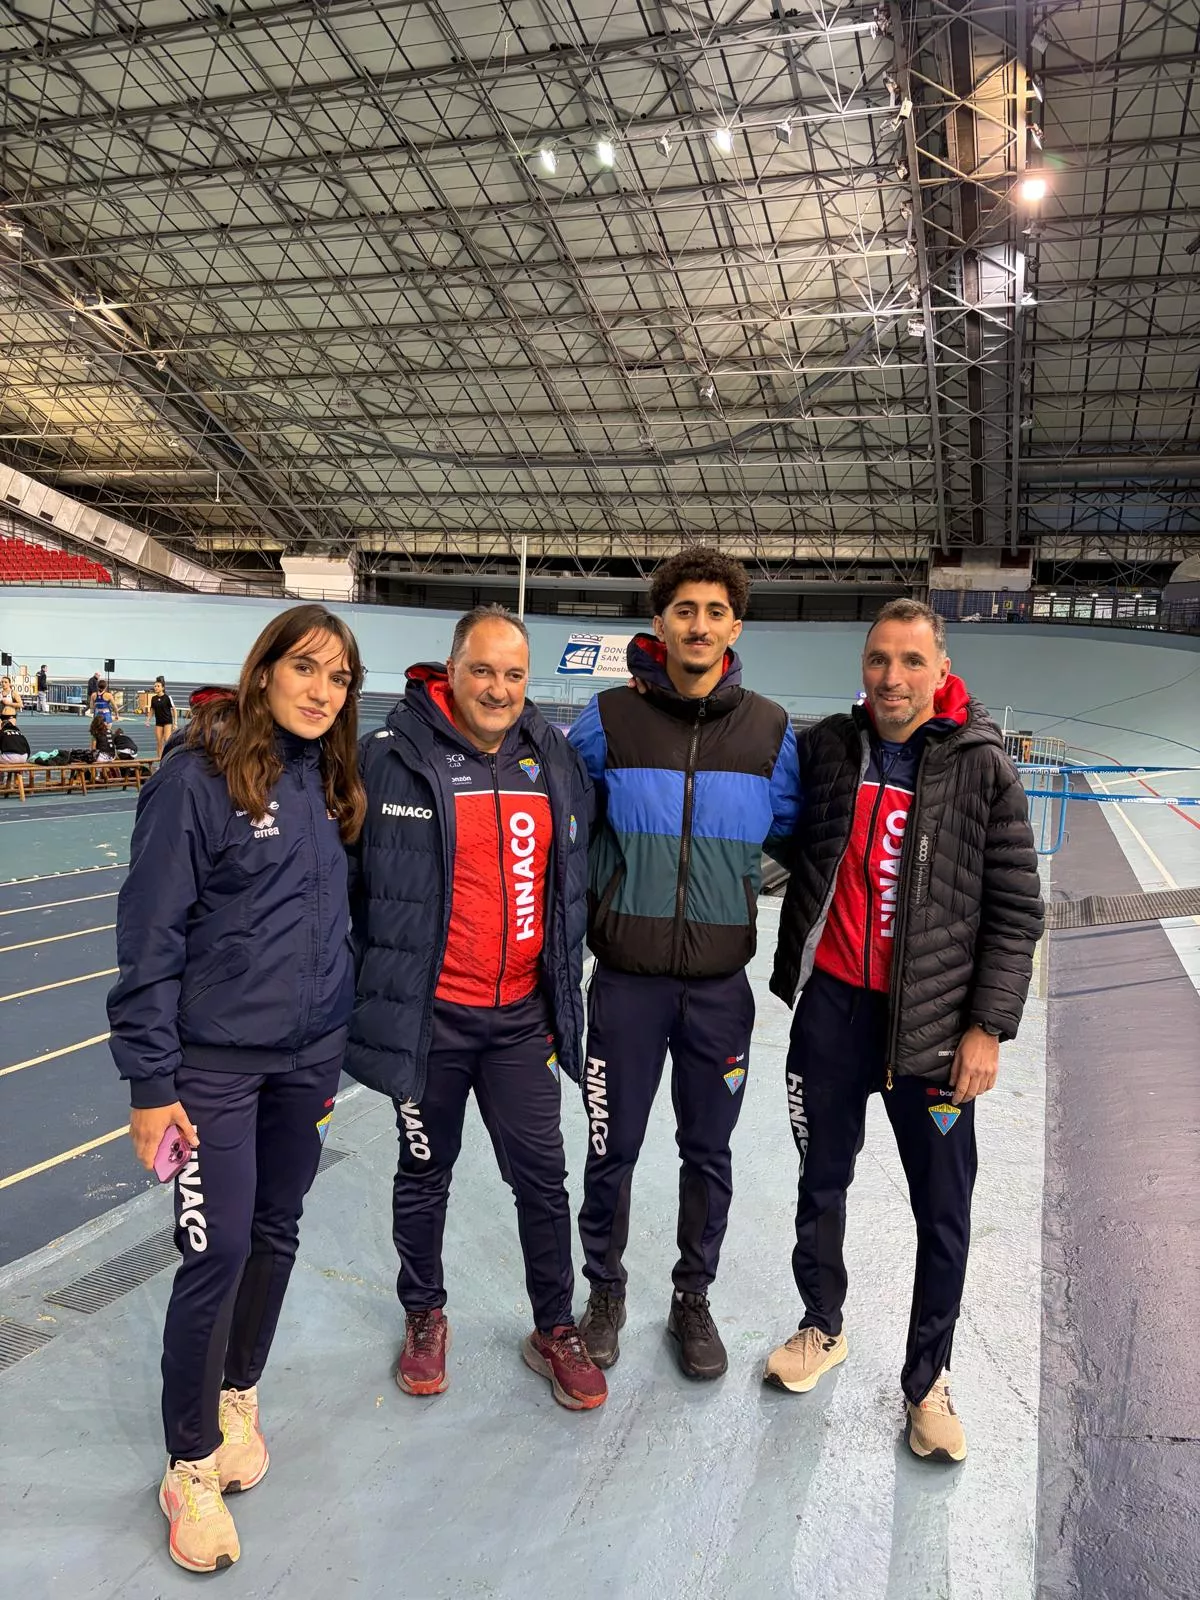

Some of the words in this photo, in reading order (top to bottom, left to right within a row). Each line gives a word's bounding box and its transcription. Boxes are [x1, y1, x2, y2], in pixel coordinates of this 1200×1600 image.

[382, 803, 433, 820] HINACO
[509, 811, 536, 941] HINACO
[586, 1056, 609, 1156] HINACO
